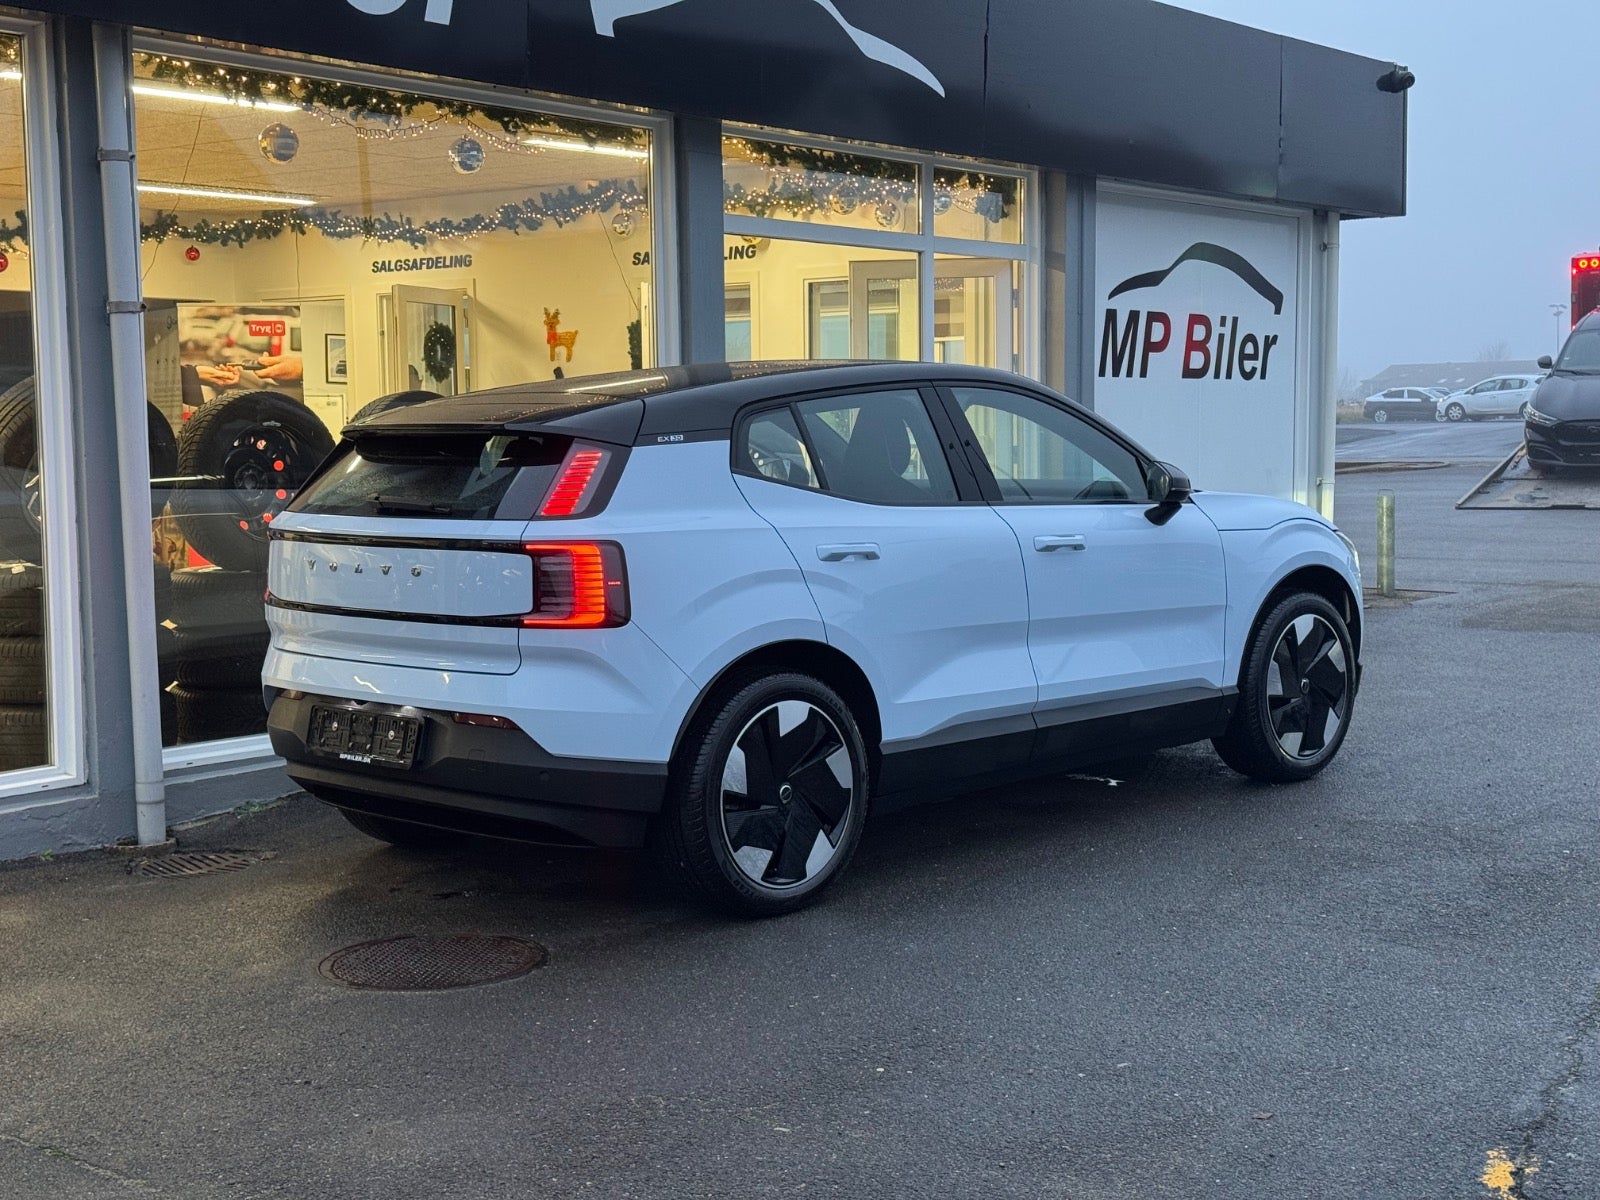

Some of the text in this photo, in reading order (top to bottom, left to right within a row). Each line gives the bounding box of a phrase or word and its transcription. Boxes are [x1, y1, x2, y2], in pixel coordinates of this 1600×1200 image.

[371, 254, 473, 273] SALGSAFDELING
[250, 324, 272, 334] Tryg
[1098, 308, 1279, 381] MP Biler
[308, 559, 422, 577] VOLVO
